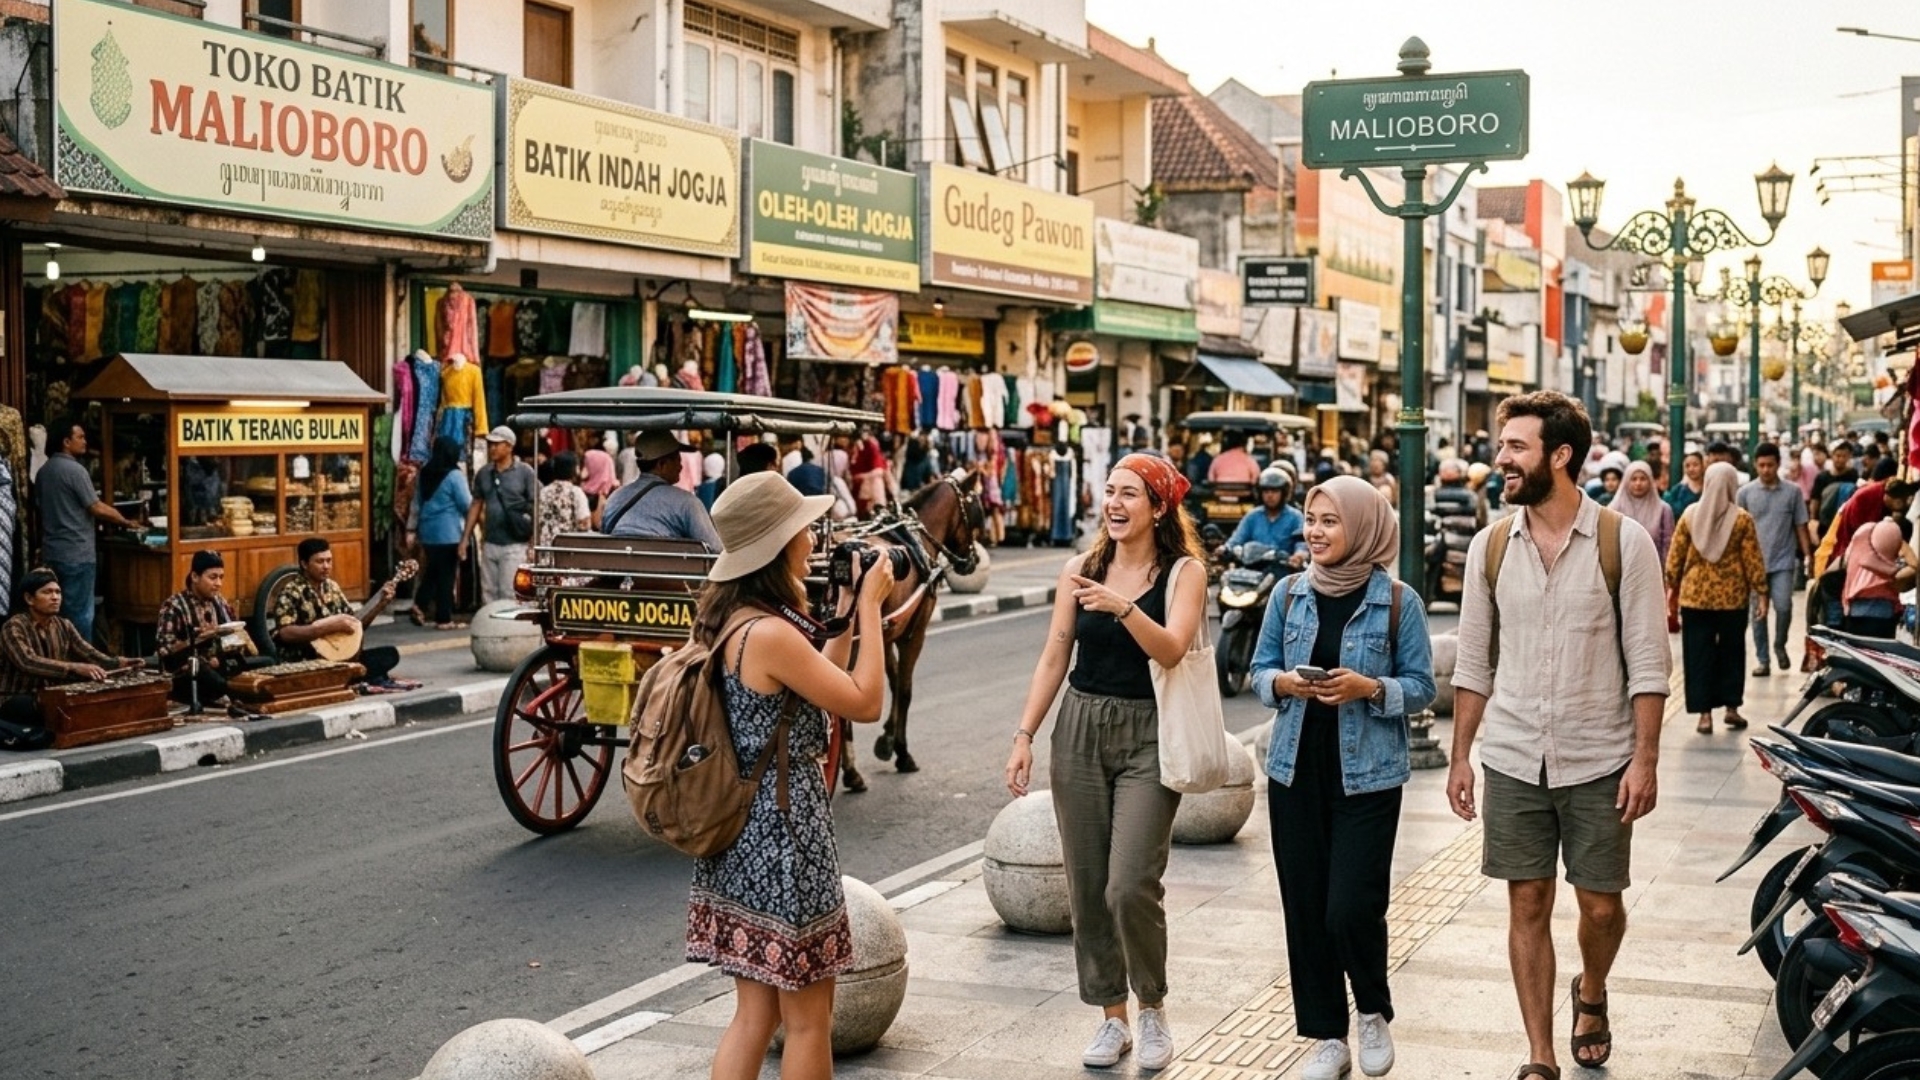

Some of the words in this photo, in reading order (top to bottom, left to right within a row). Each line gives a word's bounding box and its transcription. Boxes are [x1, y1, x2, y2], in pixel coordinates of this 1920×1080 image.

[202, 40, 301, 93] TOKO
[311, 63, 406, 114] BATIK
[149, 78, 428, 176] MALIOBORO
[1330, 112, 1499, 141] MALIOBORO
[525, 138, 591, 184] BATIK
[598, 153, 661, 195] INDAH
[667, 167, 728, 207] JOGJA
[758, 189, 858, 232] OLEH-OLEH
[862, 209, 914, 241] JOGJA
[944, 184, 1015, 247] Gudeg
[1022, 202, 1085, 251] Pawon
[183, 418, 234, 441] BATIK
[238, 418, 304, 441] TERANG
[309, 417, 359, 440] BULAN
[559, 597, 631, 623] ANDONG
[634, 601, 693, 626] JOGJA
